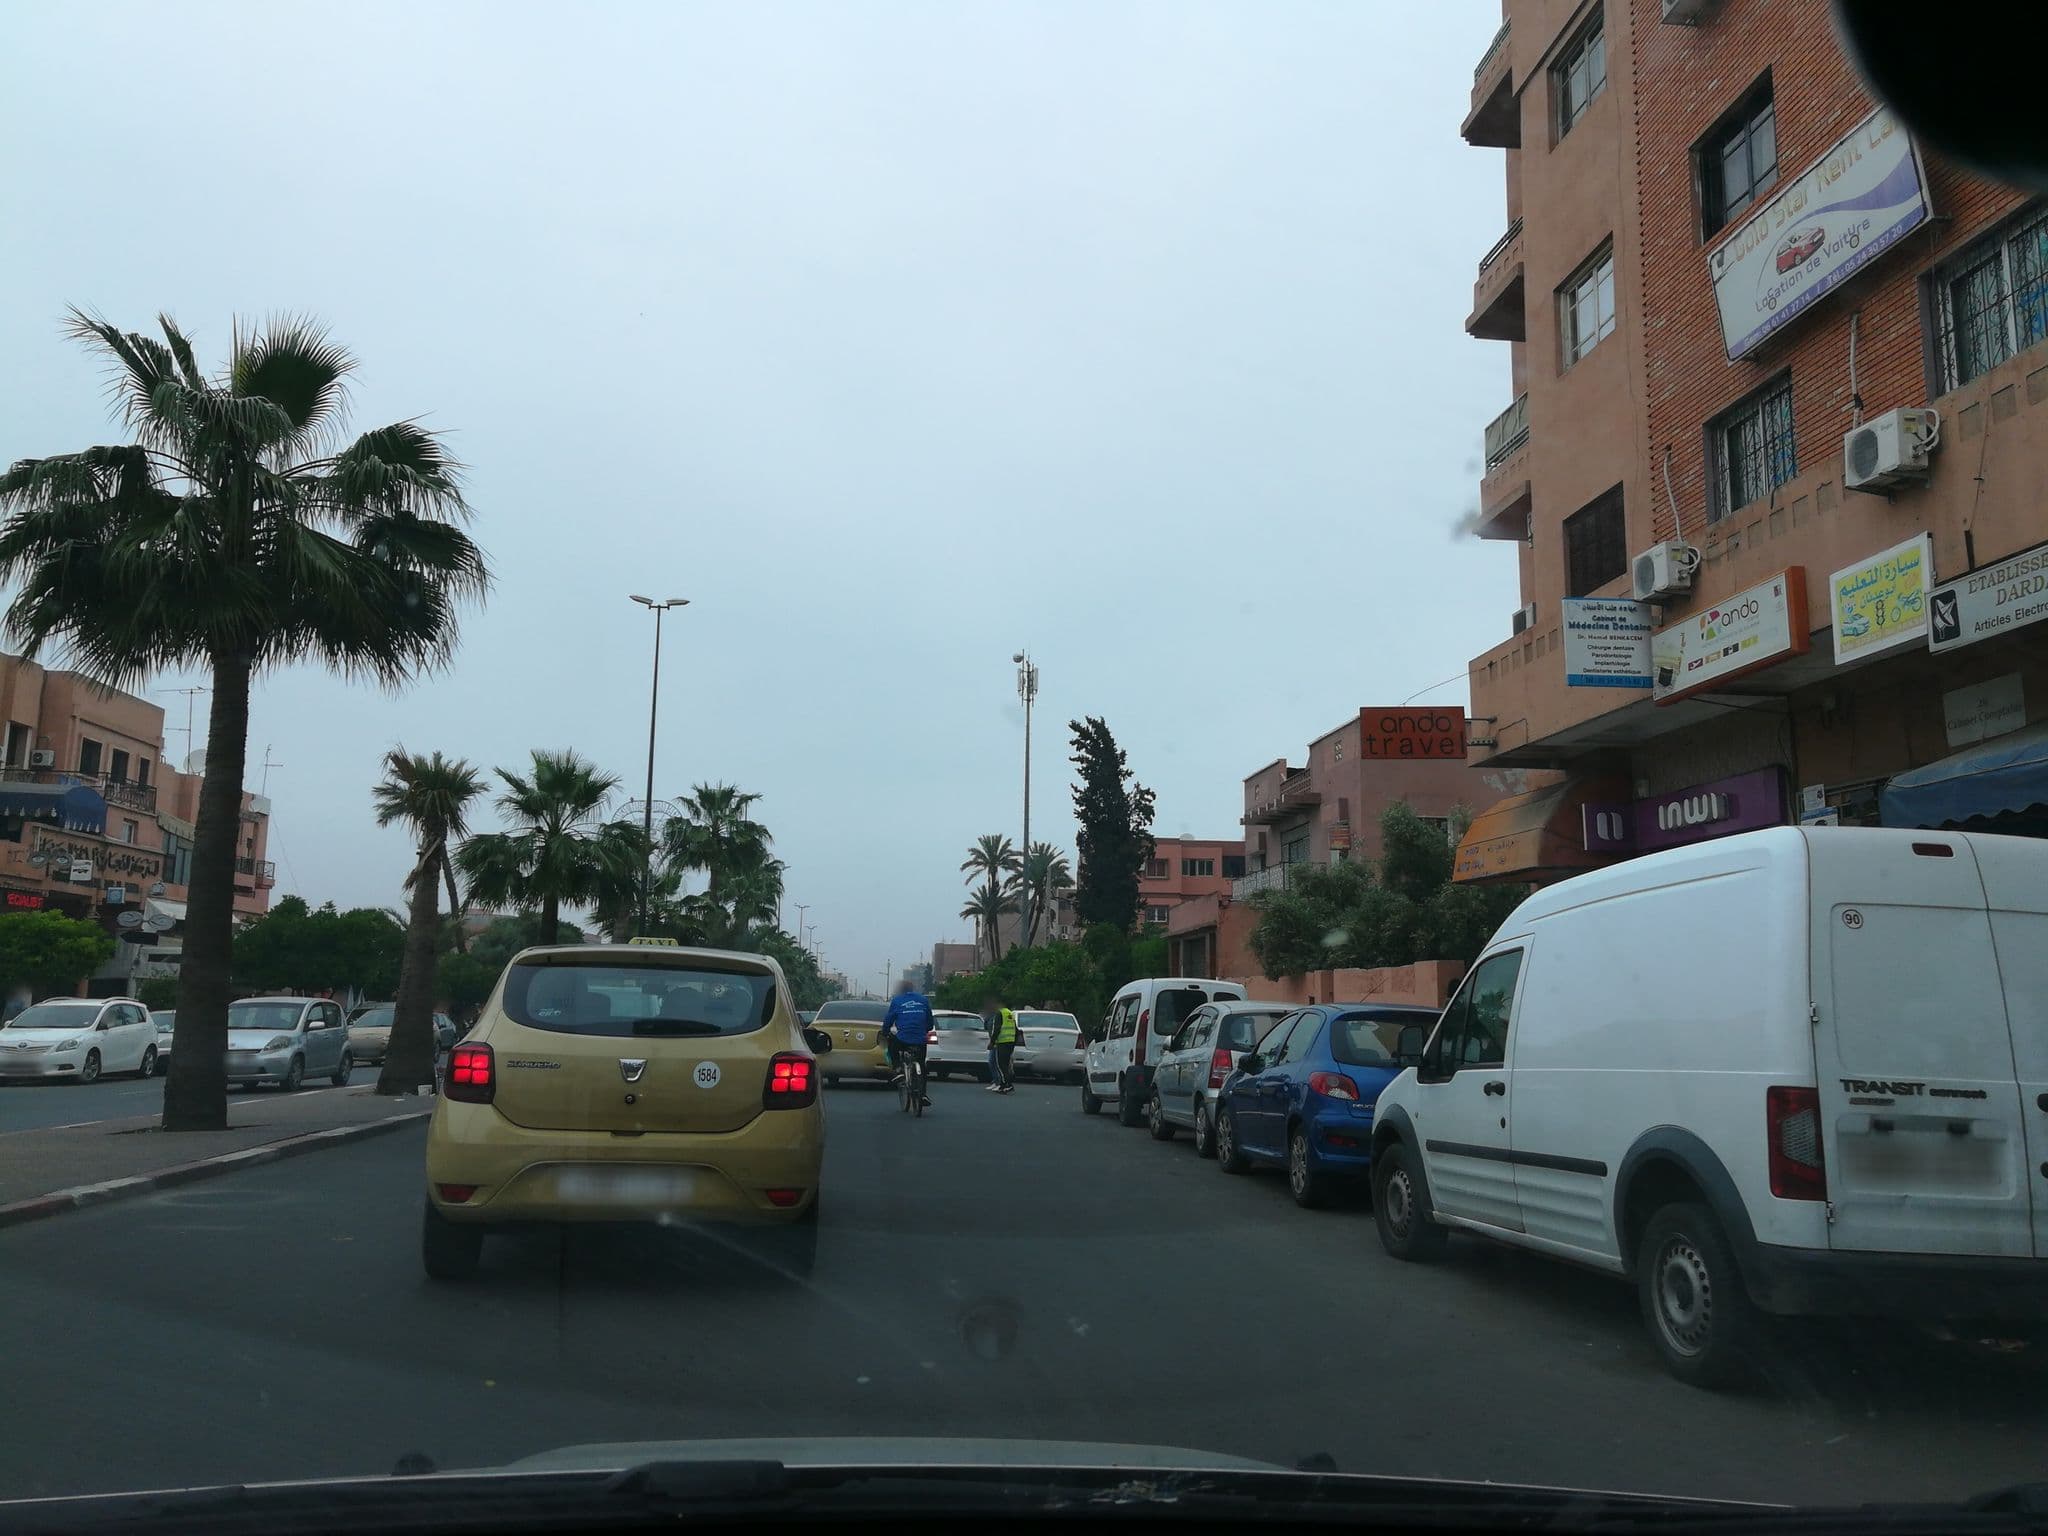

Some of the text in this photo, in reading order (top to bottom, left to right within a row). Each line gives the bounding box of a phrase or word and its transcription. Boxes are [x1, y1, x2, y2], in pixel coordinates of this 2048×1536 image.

[1816, 145, 1862, 192] Rent
[1754, 218, 1870, 312] Location de Voiture
[1995, 575, 2048, 606] DARD
[1721, 596, 1759, 627] ando
[1568, 621, 1610, 630] Médecine
[1974, 614, 2011, 633] Articles
[1380, 712, 1452, 734] ando
[1366, 731, 1465, 755] travel
[1657, 792, 1719, 831] inwi
[1845, 912, 1861, 926] 90
[638, 938, 673, 947] TAXI
[697, 1068, 717, 1083] 1584
[1839, 1078, 1925, 1096] TRANSIT
